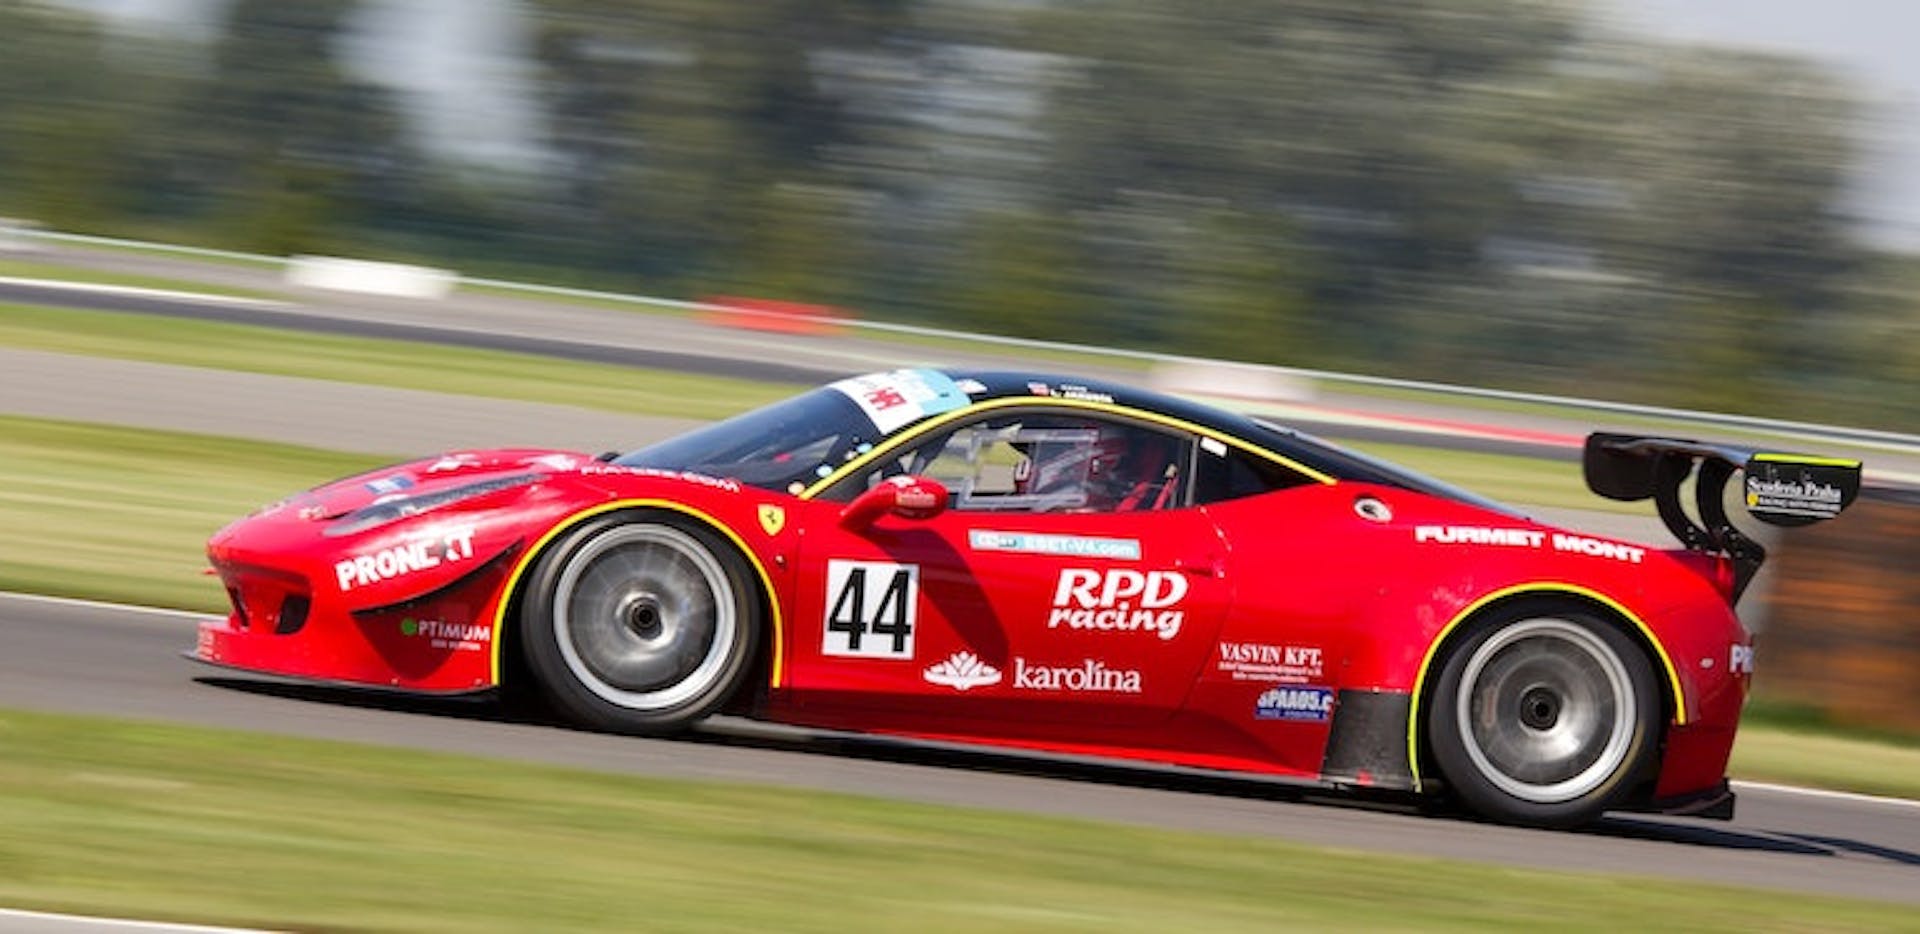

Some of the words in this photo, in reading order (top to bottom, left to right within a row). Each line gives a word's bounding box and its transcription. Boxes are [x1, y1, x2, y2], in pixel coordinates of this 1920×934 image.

[1414, 525, 1546, 549] FURMET
[1552, 533, 1645, 564] MONT
[1053, 568, 1189, 609] RPD
[828, 568, 912, 653] 44
[1048, 602, 1184, 640] racing
[1012, 656, 1142, 692] karolína
[1220, 642, 1282, 664] VASVIN
[1284, 646, 1323, 668] KFT.
